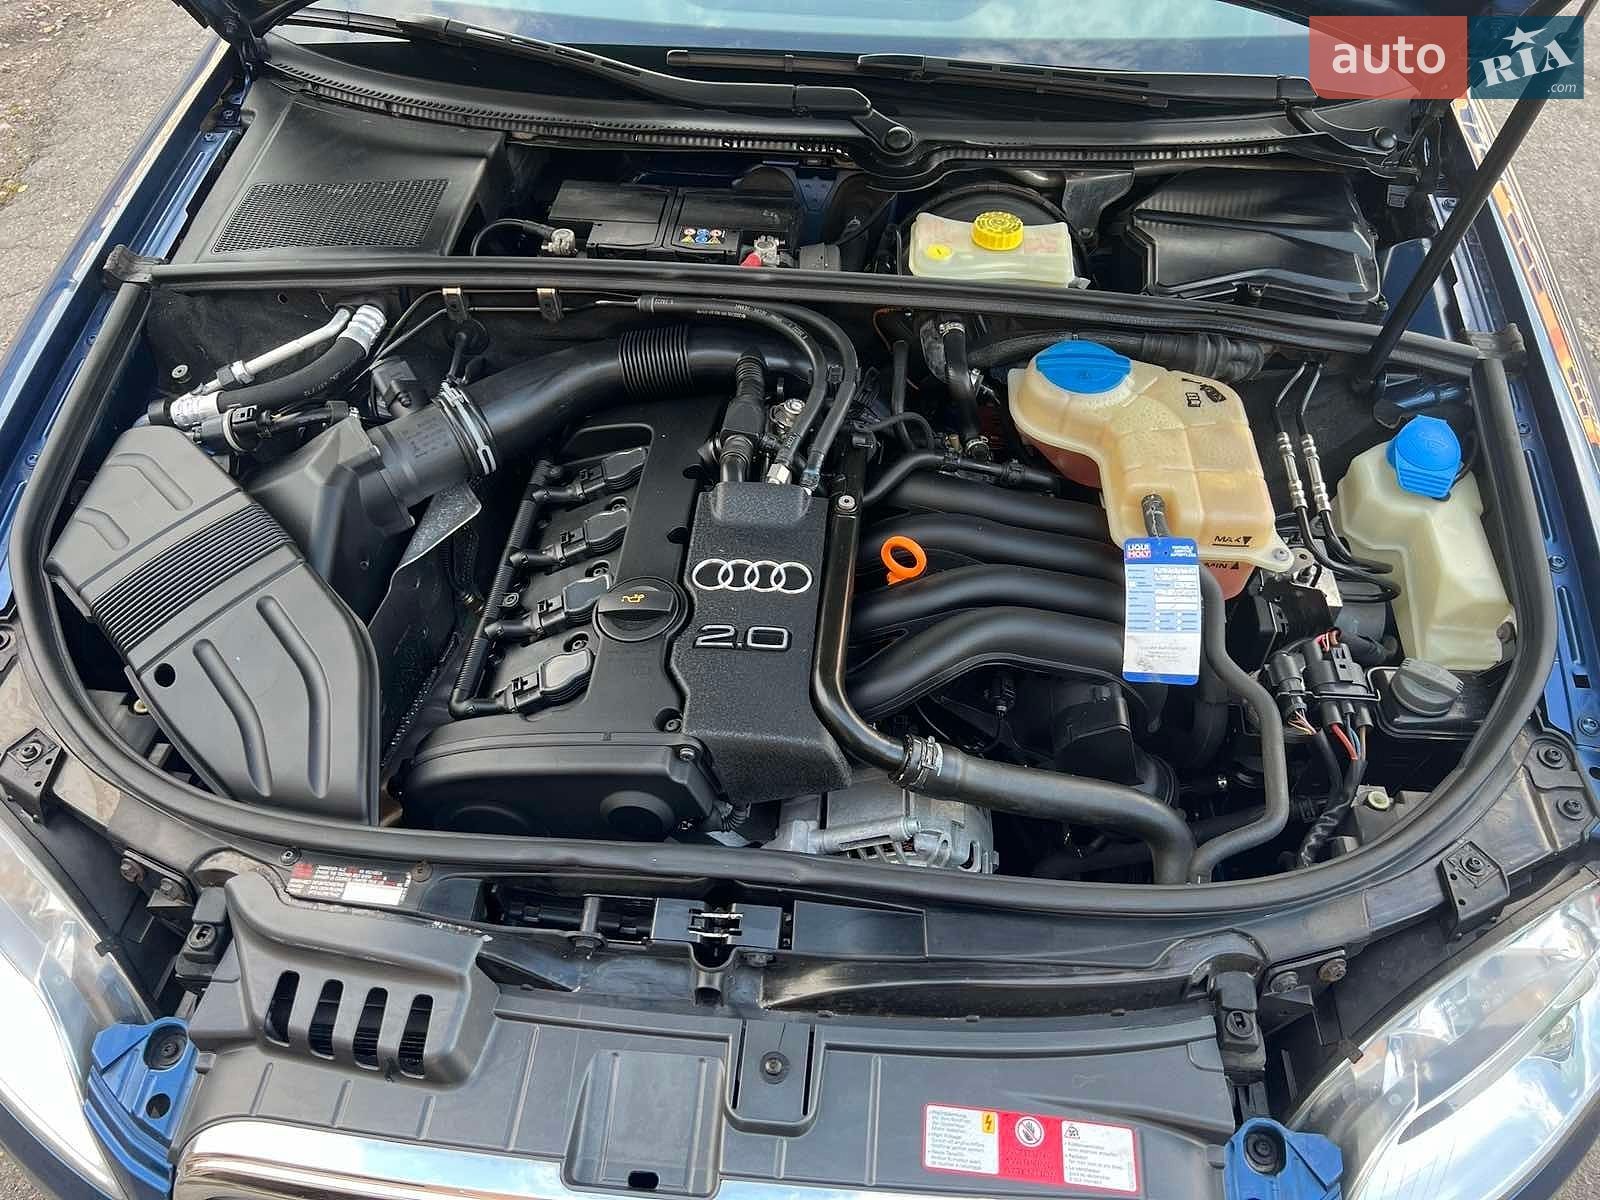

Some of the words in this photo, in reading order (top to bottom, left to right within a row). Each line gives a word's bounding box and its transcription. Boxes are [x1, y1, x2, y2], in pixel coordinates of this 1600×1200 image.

[1126, 543, 1151, 551] LIQUI
[1126, 550, 1152, 559] MOLY
[695, 624, 789, 649] 2.0
